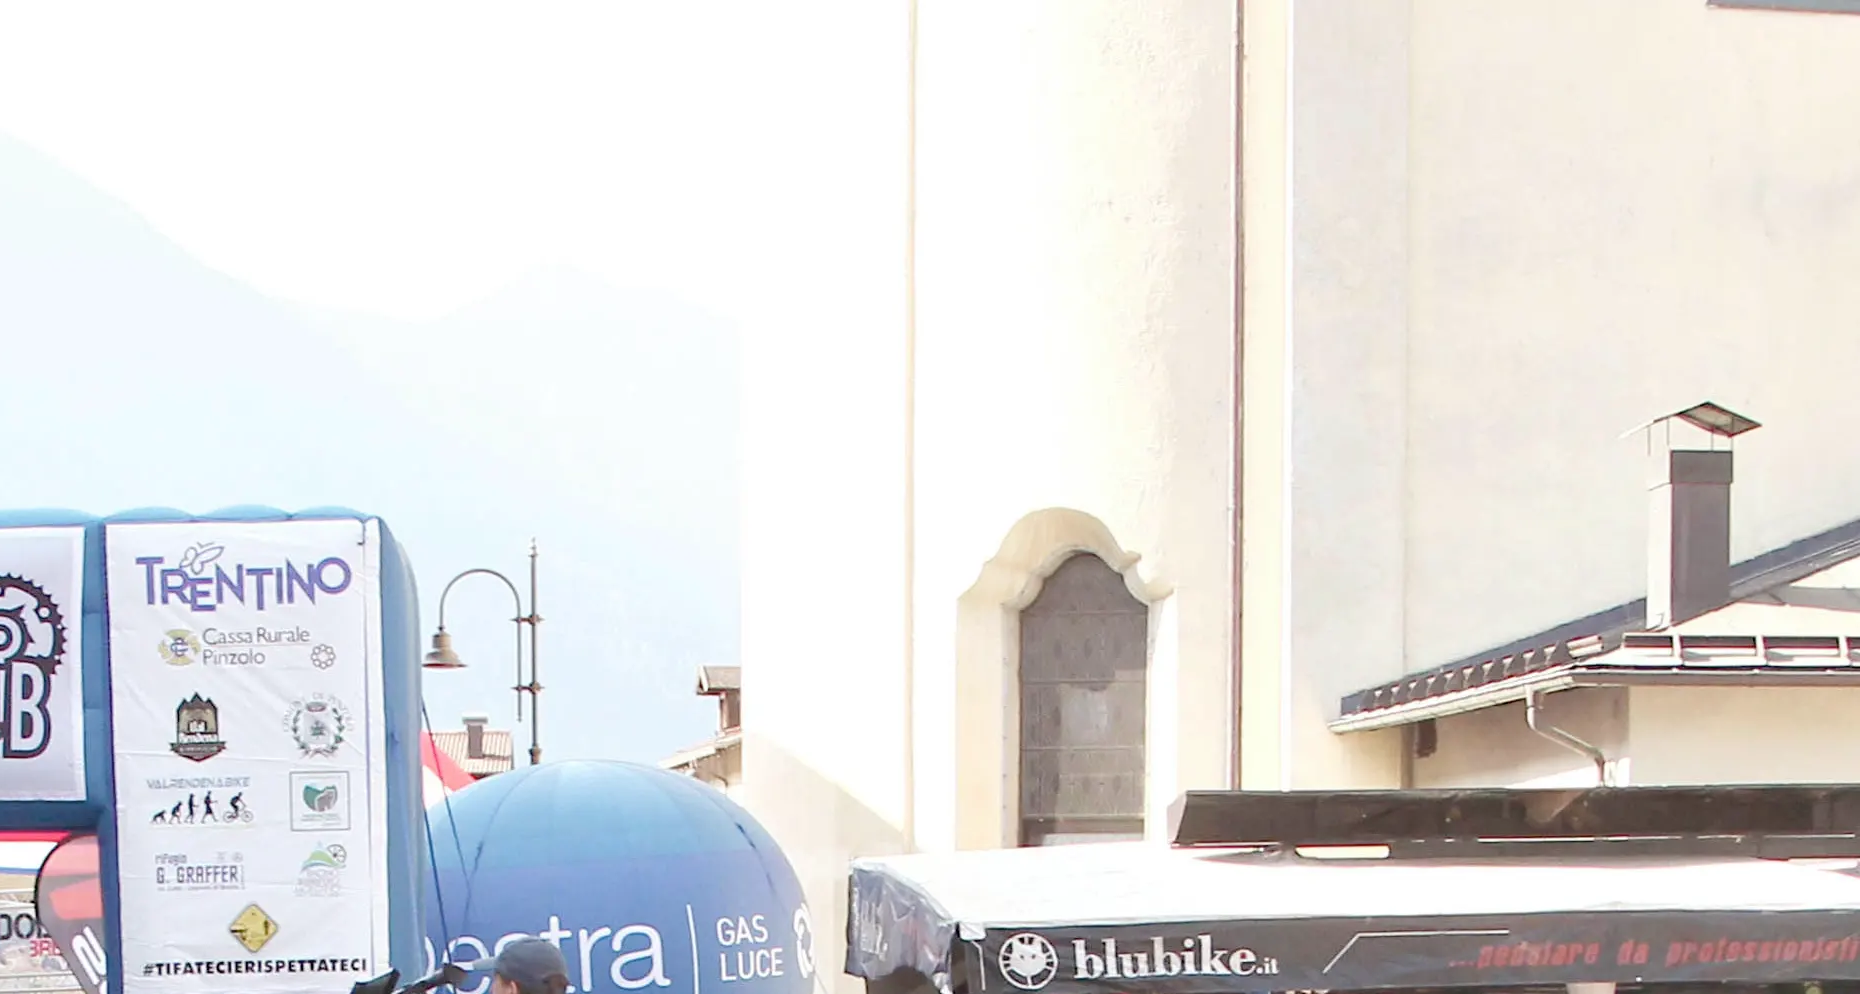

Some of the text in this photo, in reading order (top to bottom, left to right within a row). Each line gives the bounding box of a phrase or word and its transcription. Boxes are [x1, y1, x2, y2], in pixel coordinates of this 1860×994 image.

[135, 555, 352, 612] TRENTINO
[202, 626, 311, 645] Cassa Rurale
[202, 649, 267, 666] Pinzolo
[176, 865, 239, 884] GRAFFER
[715, 914, 770, 947] GAS
[718, 947, 785, 983] LUCE
[1072, 933, 1280, 981] blubike.it
[1617, 938, 1650, 966] da
[143, 958, 368, 977] #TIFATECIERISPETTATECI
